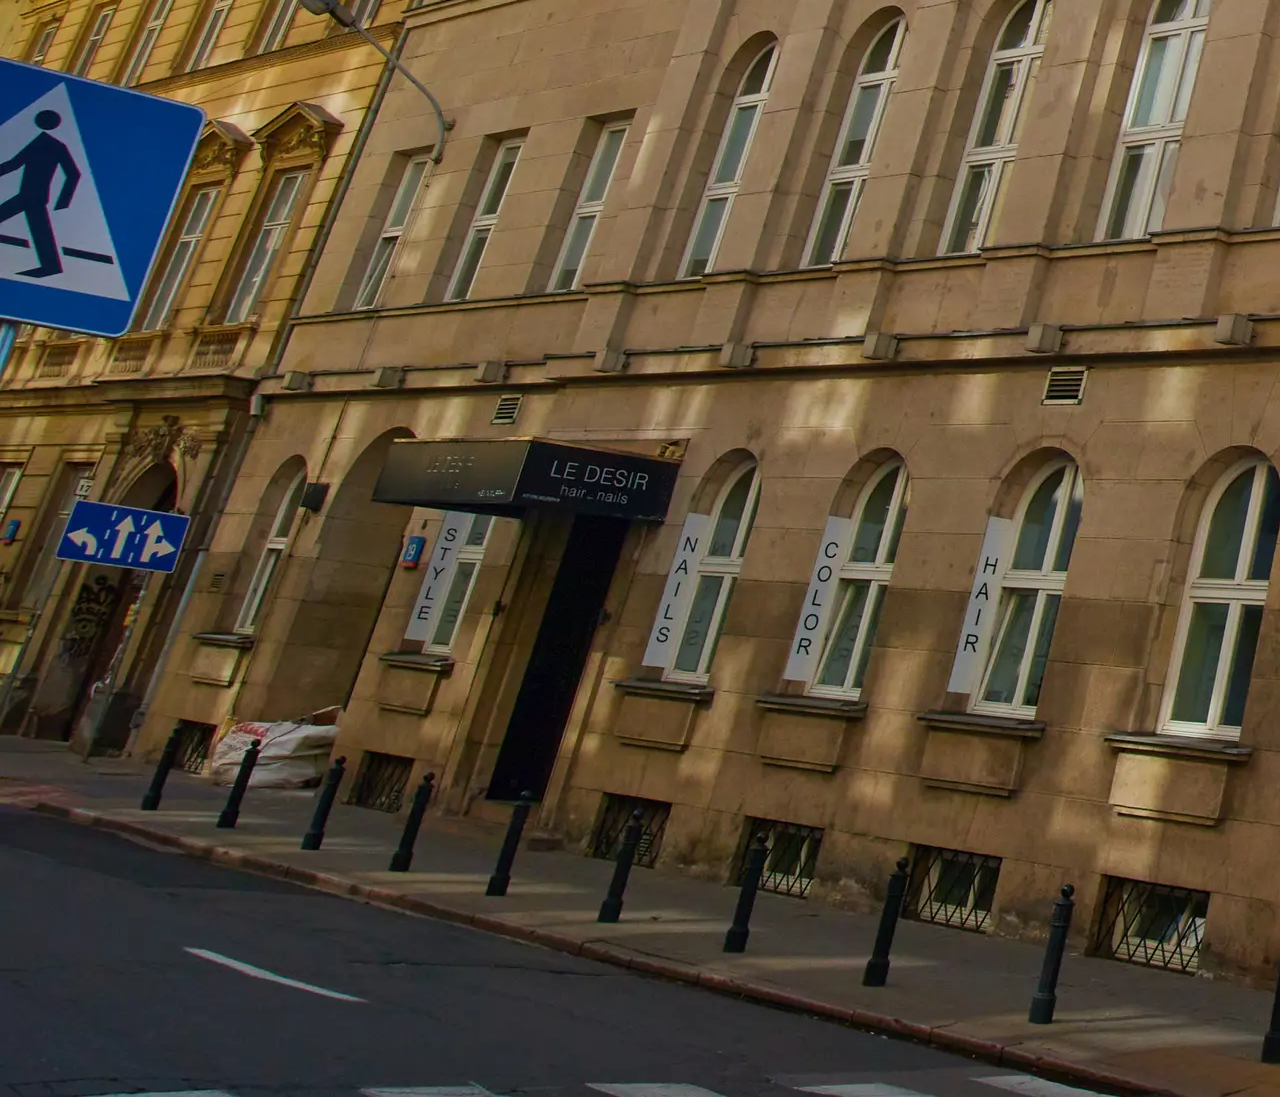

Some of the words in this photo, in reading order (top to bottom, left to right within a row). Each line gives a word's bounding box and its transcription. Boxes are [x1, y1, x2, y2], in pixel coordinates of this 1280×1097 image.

[79, 484, 92, 493] 17
[550, 460, 579, 480] LE
[584, 465, 649, 490] DESIR
[560, 484, 586, 498] hair
[596, 491, 628, 504] nails
[417, 528, 457, 620] STYLE
[656, 536, 698, 643] NAILS
[796, 542, 839, 655] COLOR
[963, 556, 998, 652] HAIR
